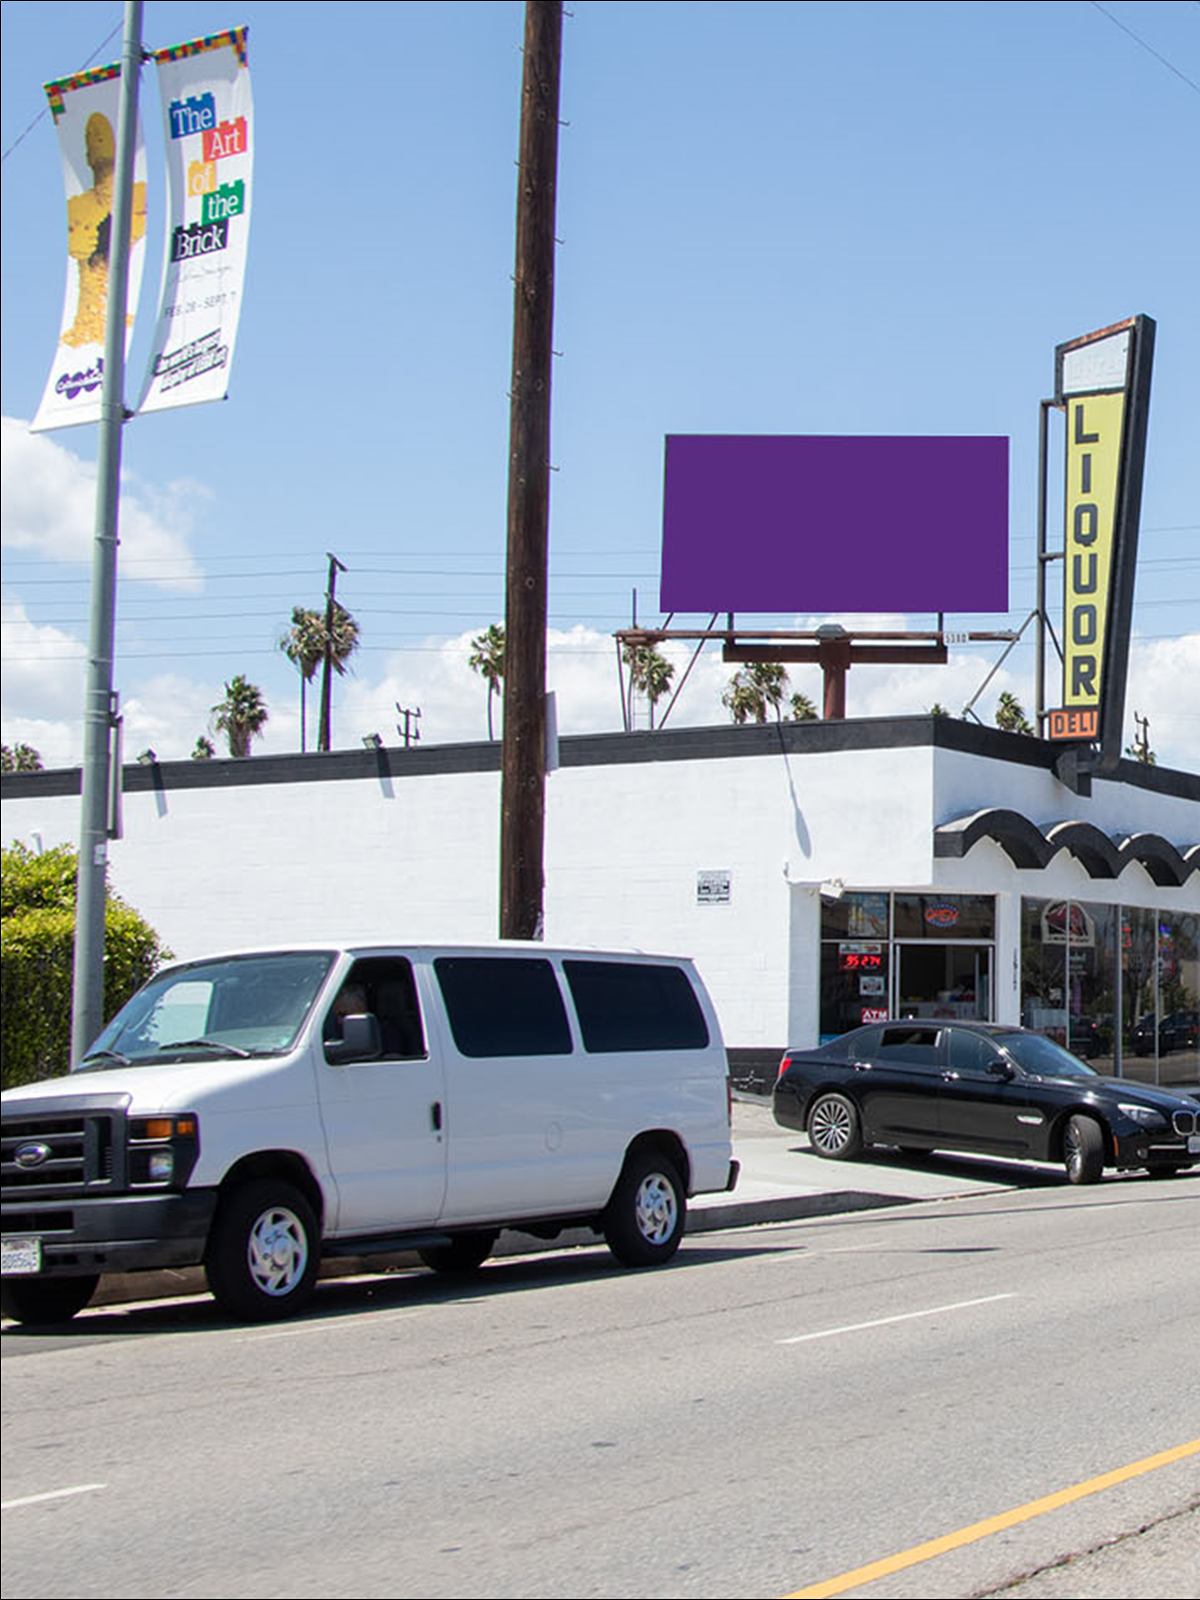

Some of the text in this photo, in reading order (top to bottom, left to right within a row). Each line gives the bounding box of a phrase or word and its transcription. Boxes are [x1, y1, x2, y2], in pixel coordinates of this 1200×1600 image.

[173, 107, 213, 135] The
[209, 128, 241, 158] Art
[192, 164, 214, 193] of
[208, 193, 240, 220] the
[176, 225, 225, 260] Brick
[1072, 404, 1100, 697] LIQUOR
[1054, 711, 1096, 736] DELI
[863, 1010, 887, 1020] ATM
